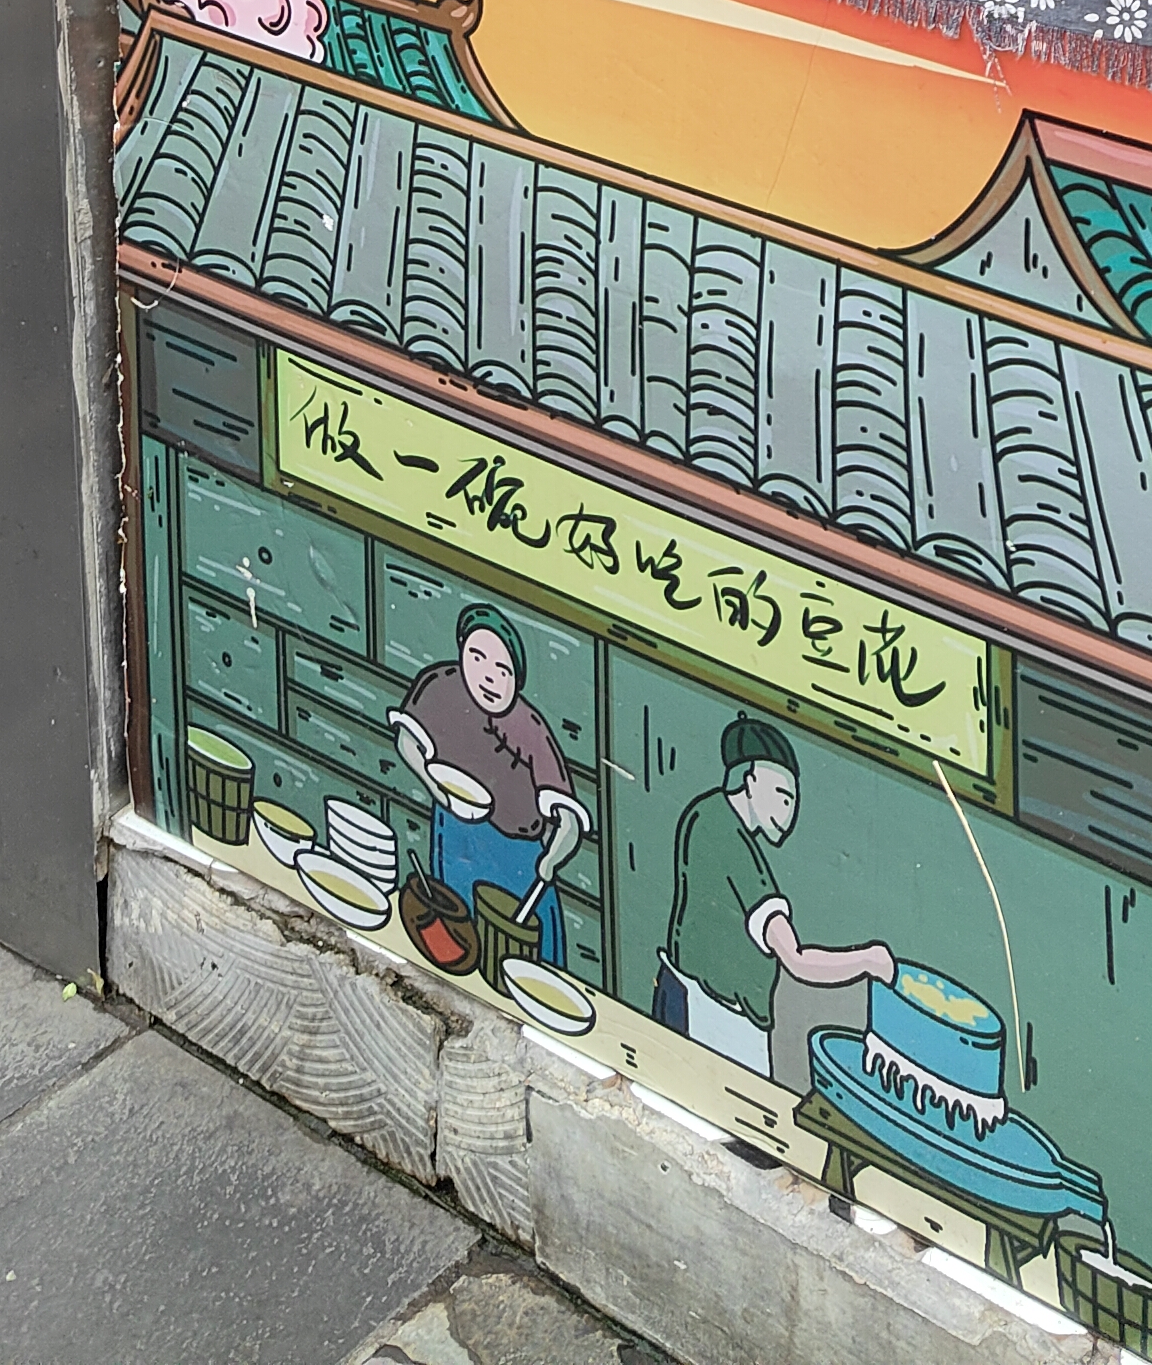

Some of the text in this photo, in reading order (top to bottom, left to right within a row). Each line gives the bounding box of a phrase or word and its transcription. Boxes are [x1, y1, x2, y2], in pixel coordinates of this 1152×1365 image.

[291, 385, 946, 707] 做一碗好吃的豆花
